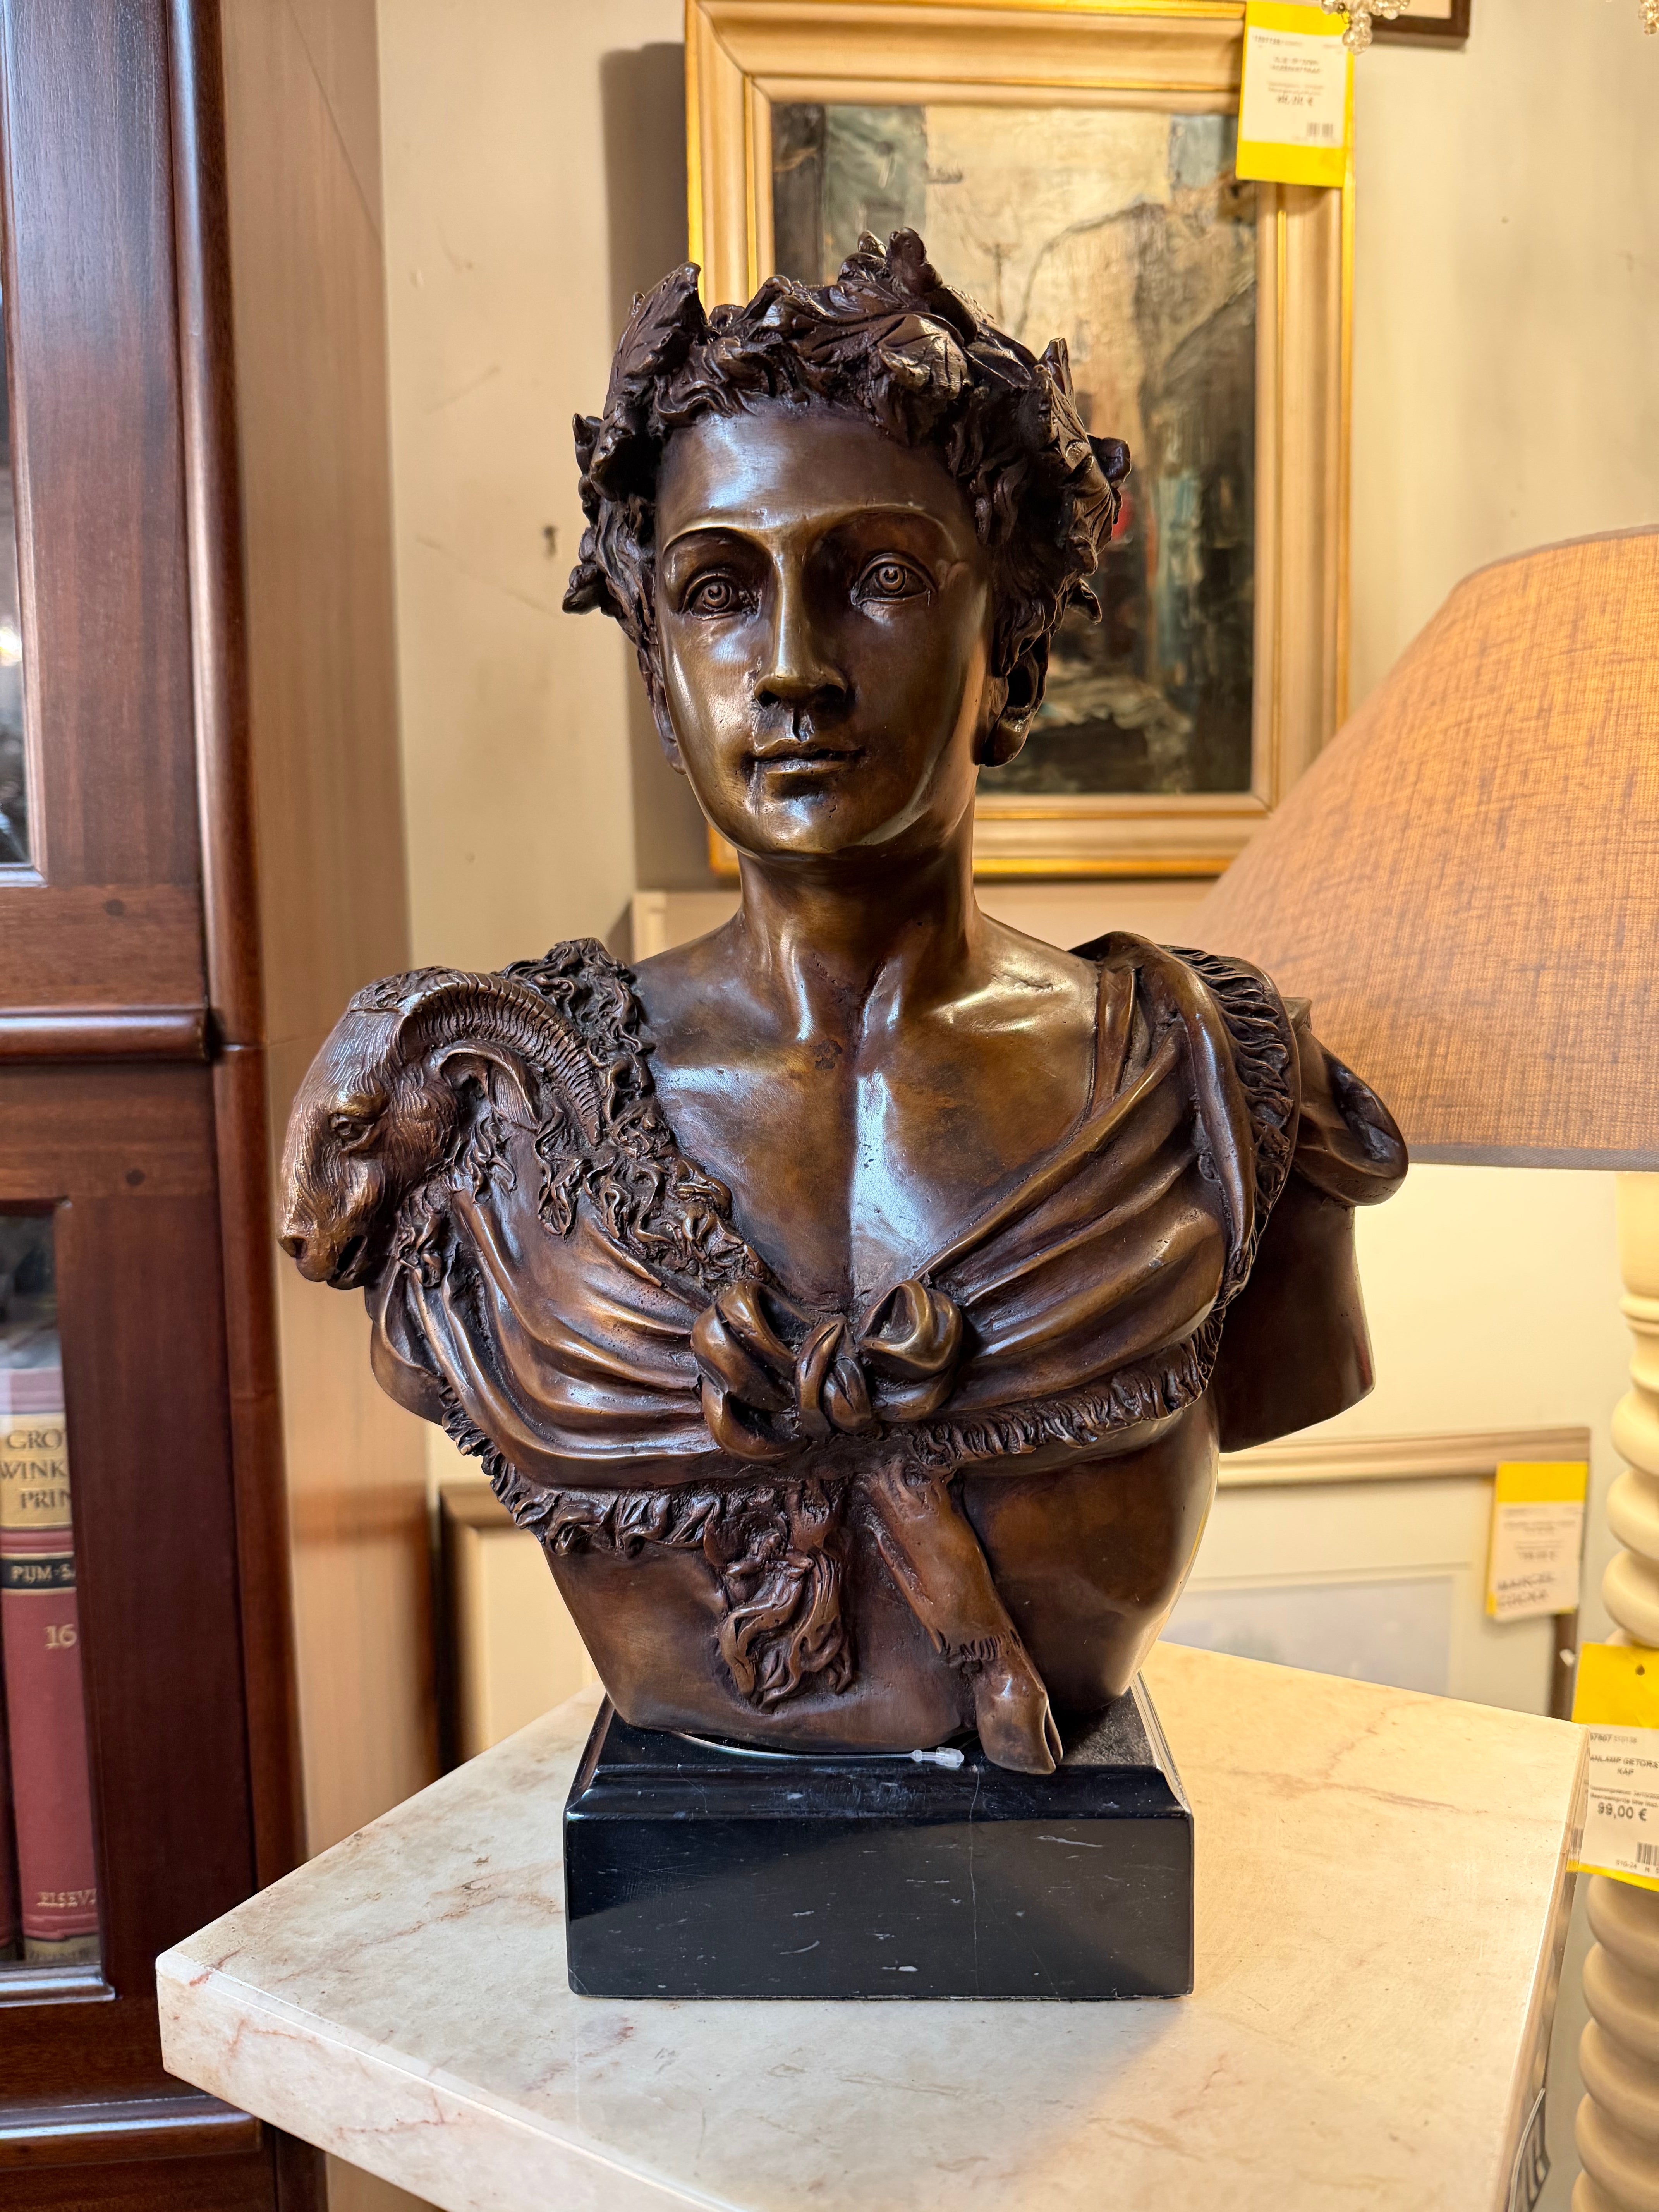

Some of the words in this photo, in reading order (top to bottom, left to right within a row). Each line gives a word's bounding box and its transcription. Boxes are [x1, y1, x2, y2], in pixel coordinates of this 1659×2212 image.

[45, 1624, 77, 1650] 16
[1597, 1802, 1633, 1819] 99,00
[1638, 1808, 1647, 1822] €
